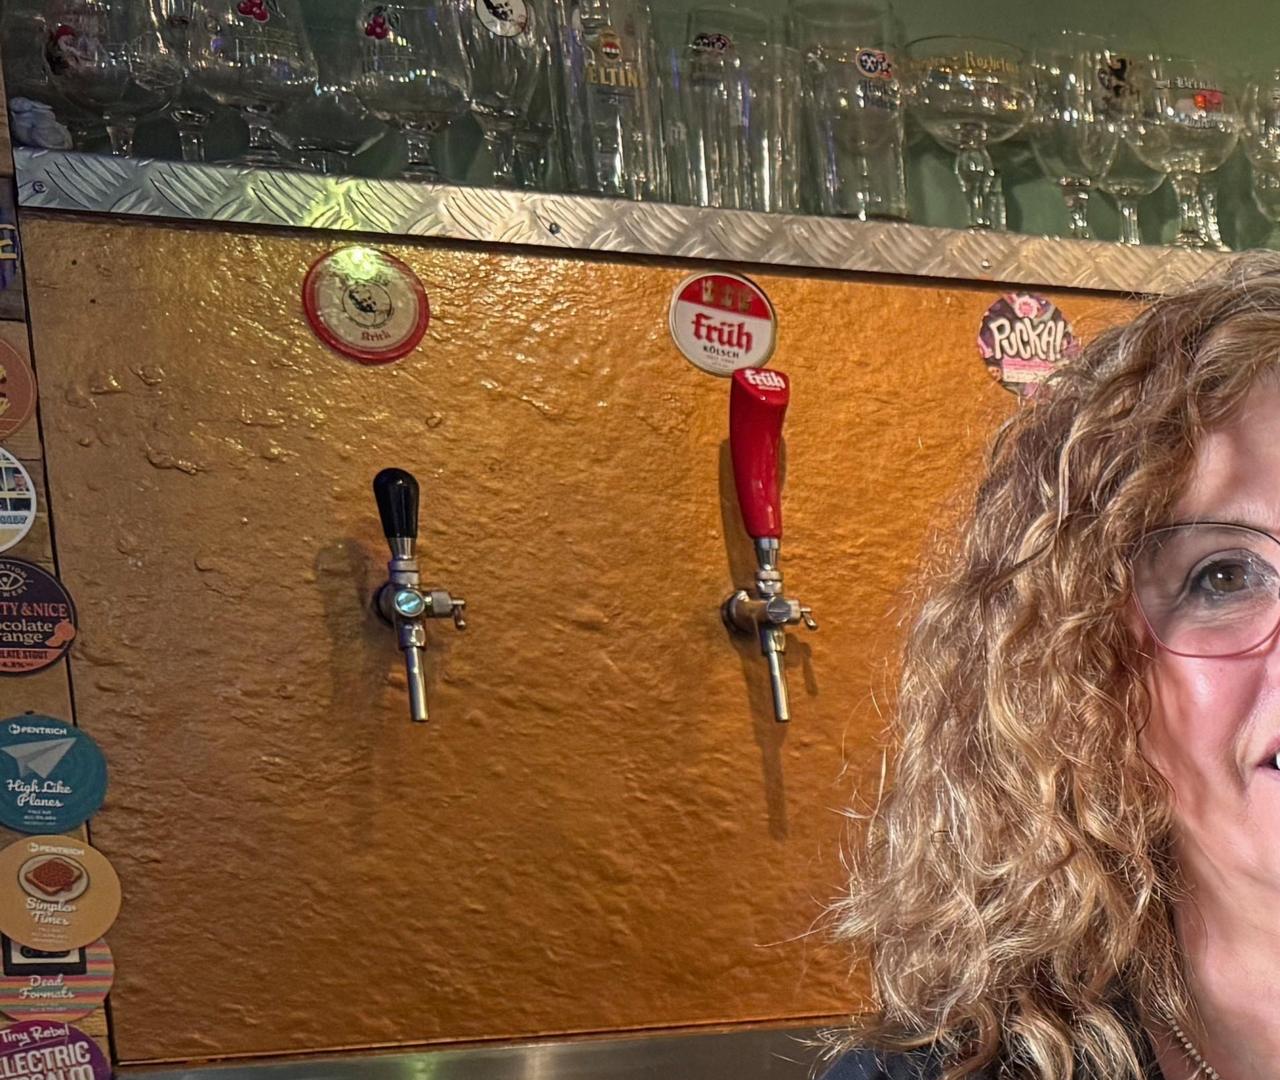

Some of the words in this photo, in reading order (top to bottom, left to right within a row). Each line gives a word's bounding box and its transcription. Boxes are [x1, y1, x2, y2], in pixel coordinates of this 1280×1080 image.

[703, 345, 740, 359] KÖLSCH
[20, 727, 68, 736] PENTRICH
[6, 779, 40, 795] High
[42, 780, 73, 794] Like
[16, 793, 65, 808] Planes
[29, 973, 65, 988] Dead
[0, 1029, 32, 1048] Tiny
[29, 1023, 70, 1040] Rebel
